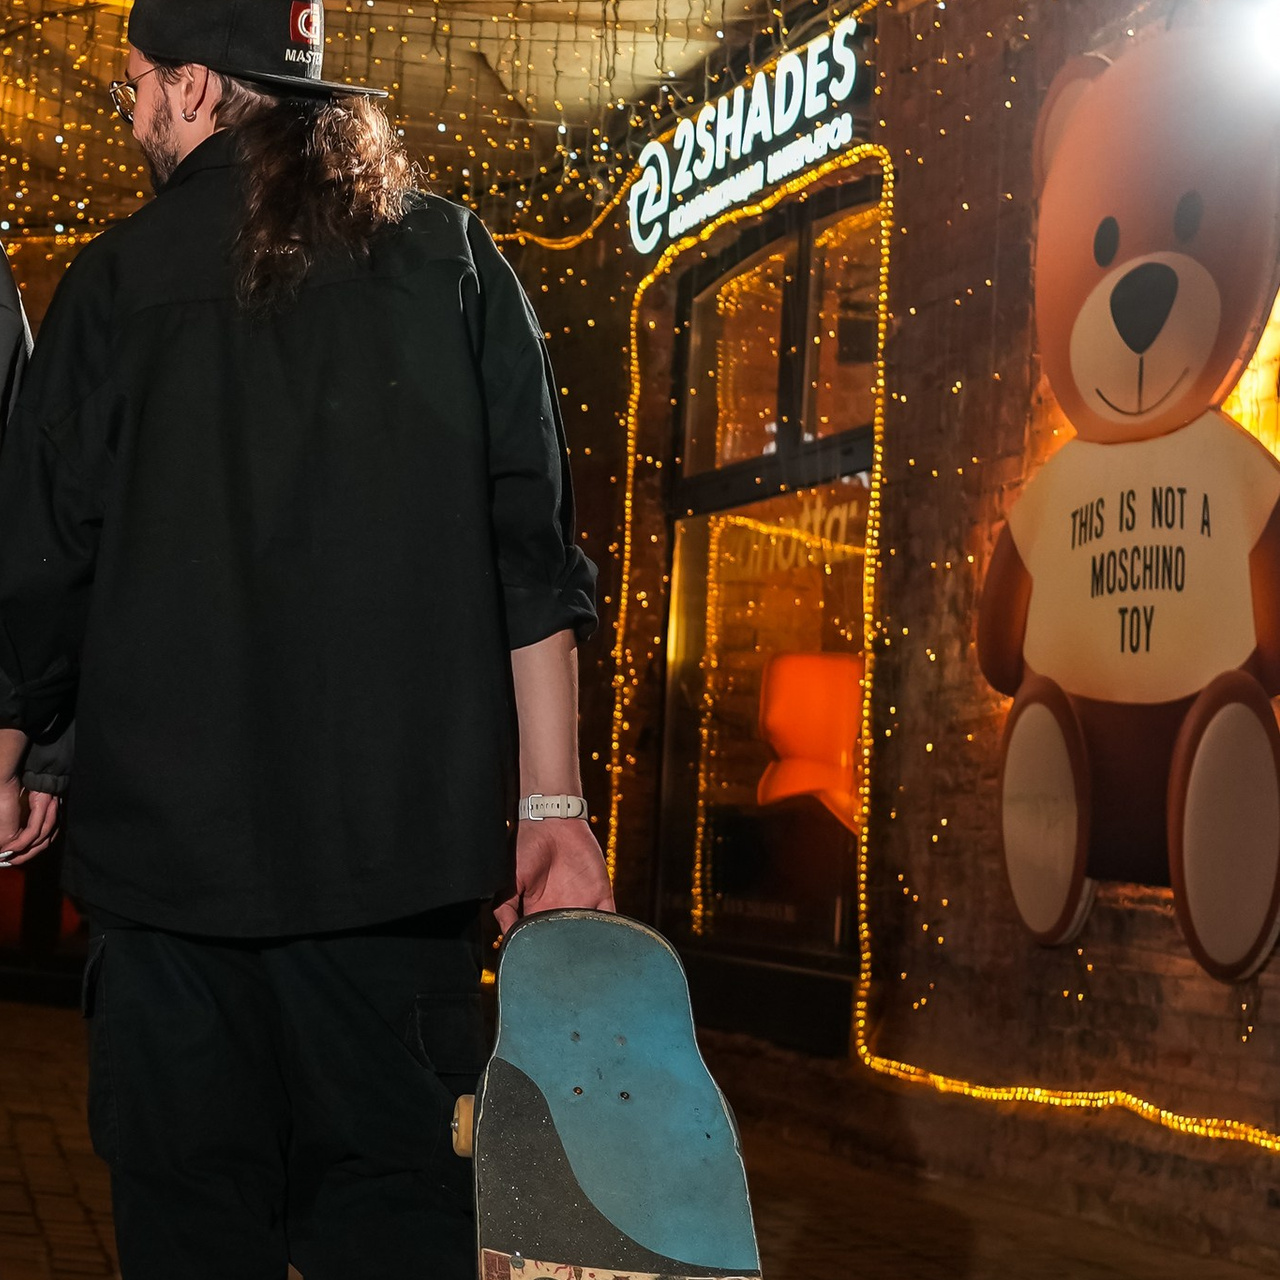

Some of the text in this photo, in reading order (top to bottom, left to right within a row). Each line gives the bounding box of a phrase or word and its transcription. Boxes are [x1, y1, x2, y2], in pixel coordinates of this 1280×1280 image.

[672, 17, 857, 194] 2SHADES
[1071, 486, 1212, 551] THIS IS NOT A
[1090, 545, 1186, 598] MOSCHINO
[1118, 605, 1154, 654] TOY
